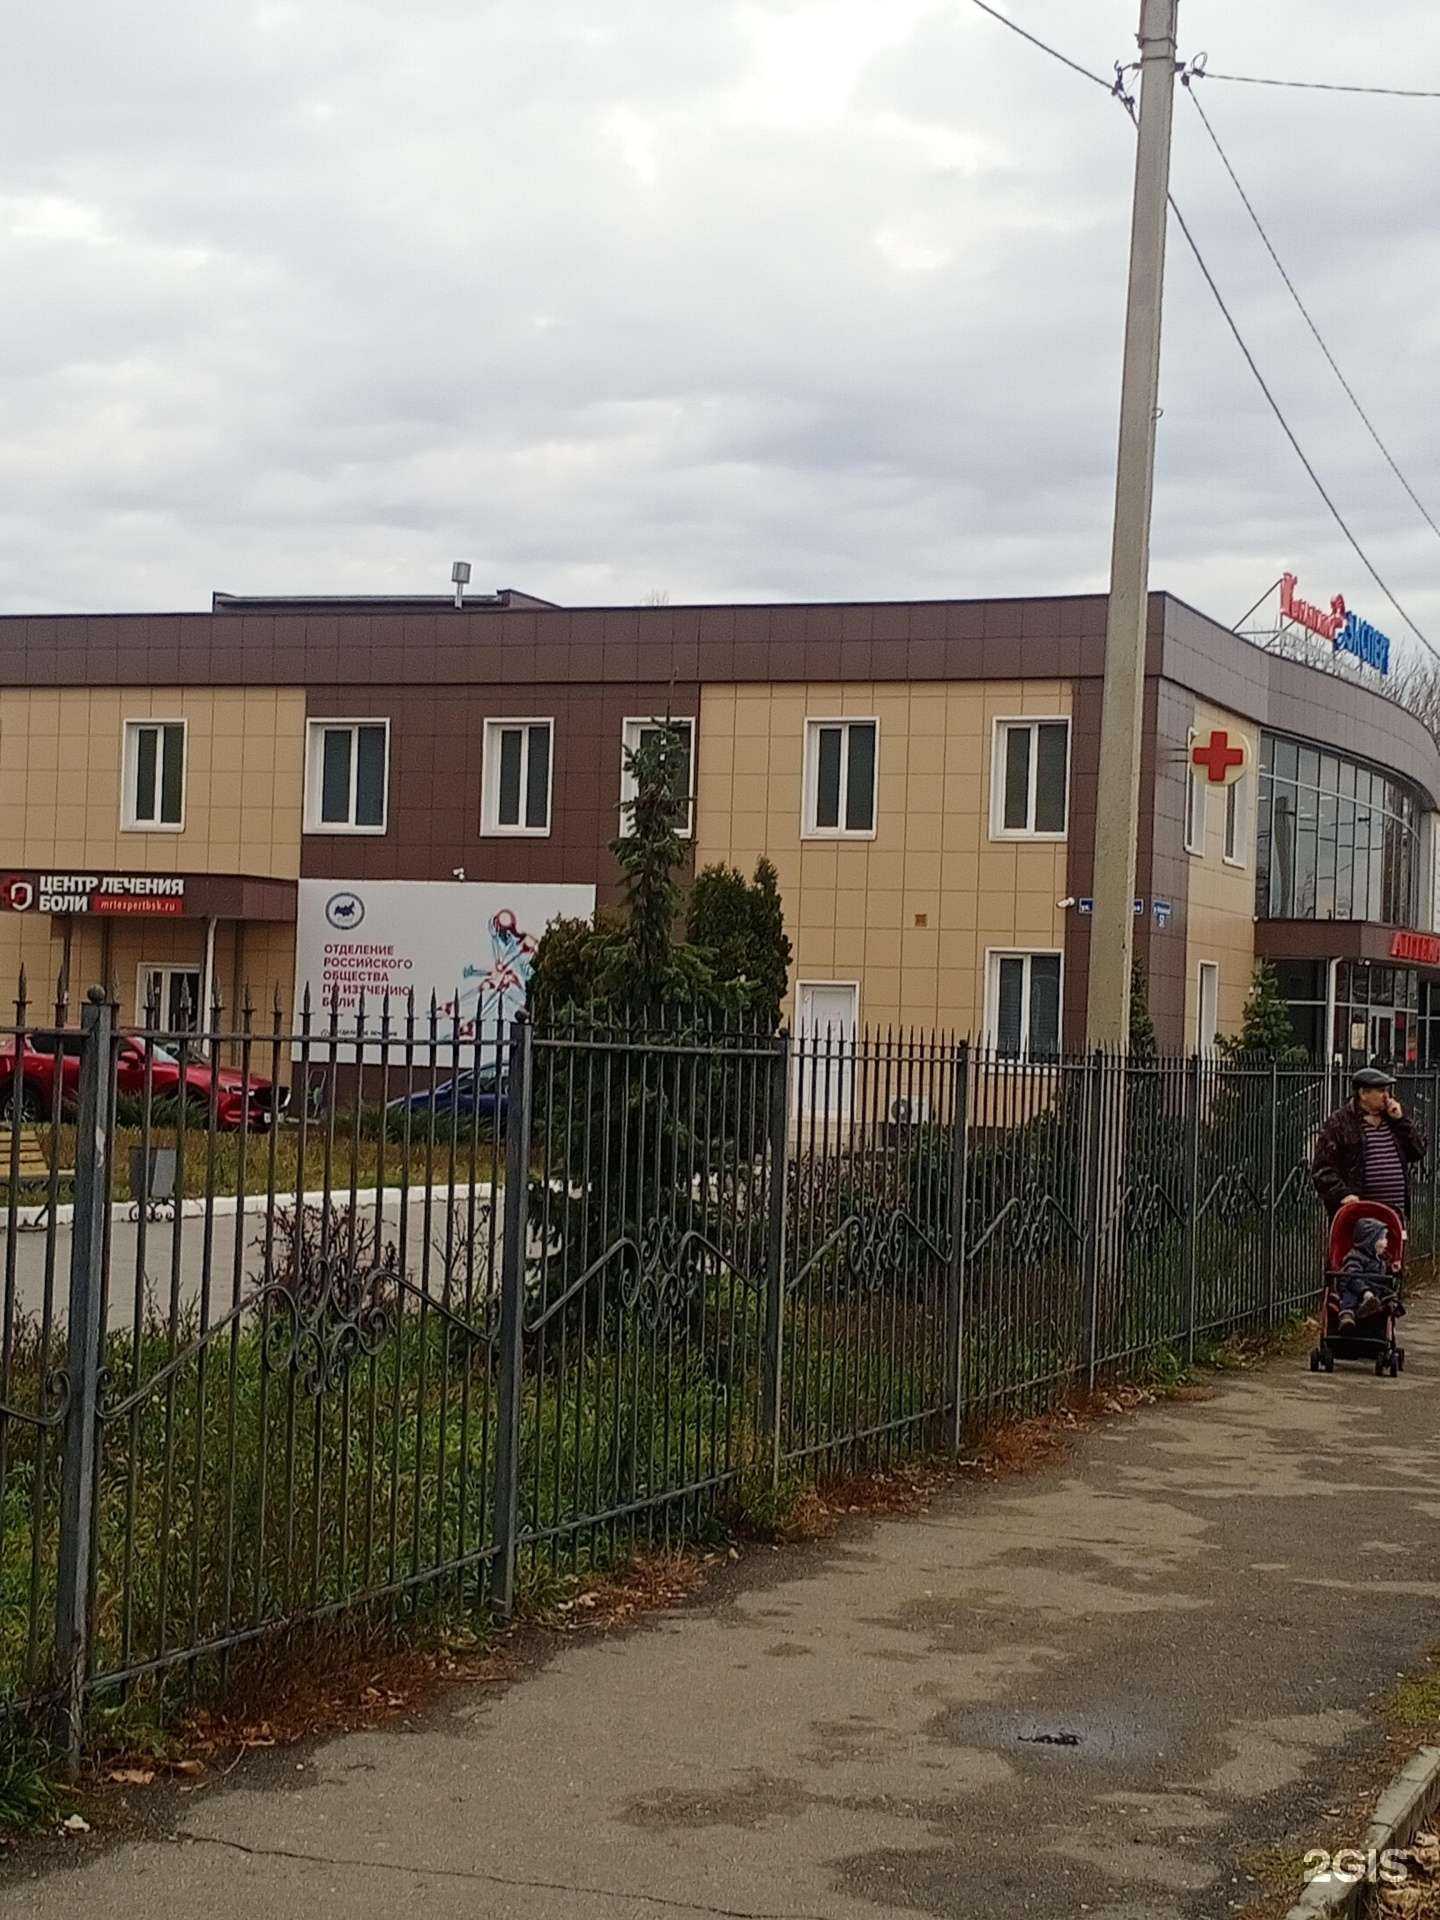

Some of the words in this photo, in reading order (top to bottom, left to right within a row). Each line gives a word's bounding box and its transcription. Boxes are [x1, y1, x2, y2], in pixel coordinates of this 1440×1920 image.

[39, 875, 98, 894] ЦЕНТР
[100, 877, 184, 896] ЛЕЧЕНИЯ
[39, 895, 88, 912] БОЛИ
[324, 944, 394, 956] ОТДЕЛЕНИЕ
[323, 957, 413, 969] РОССИЙСКОГО
[323, 971, 389, 982] ОБЩЕСТВА
